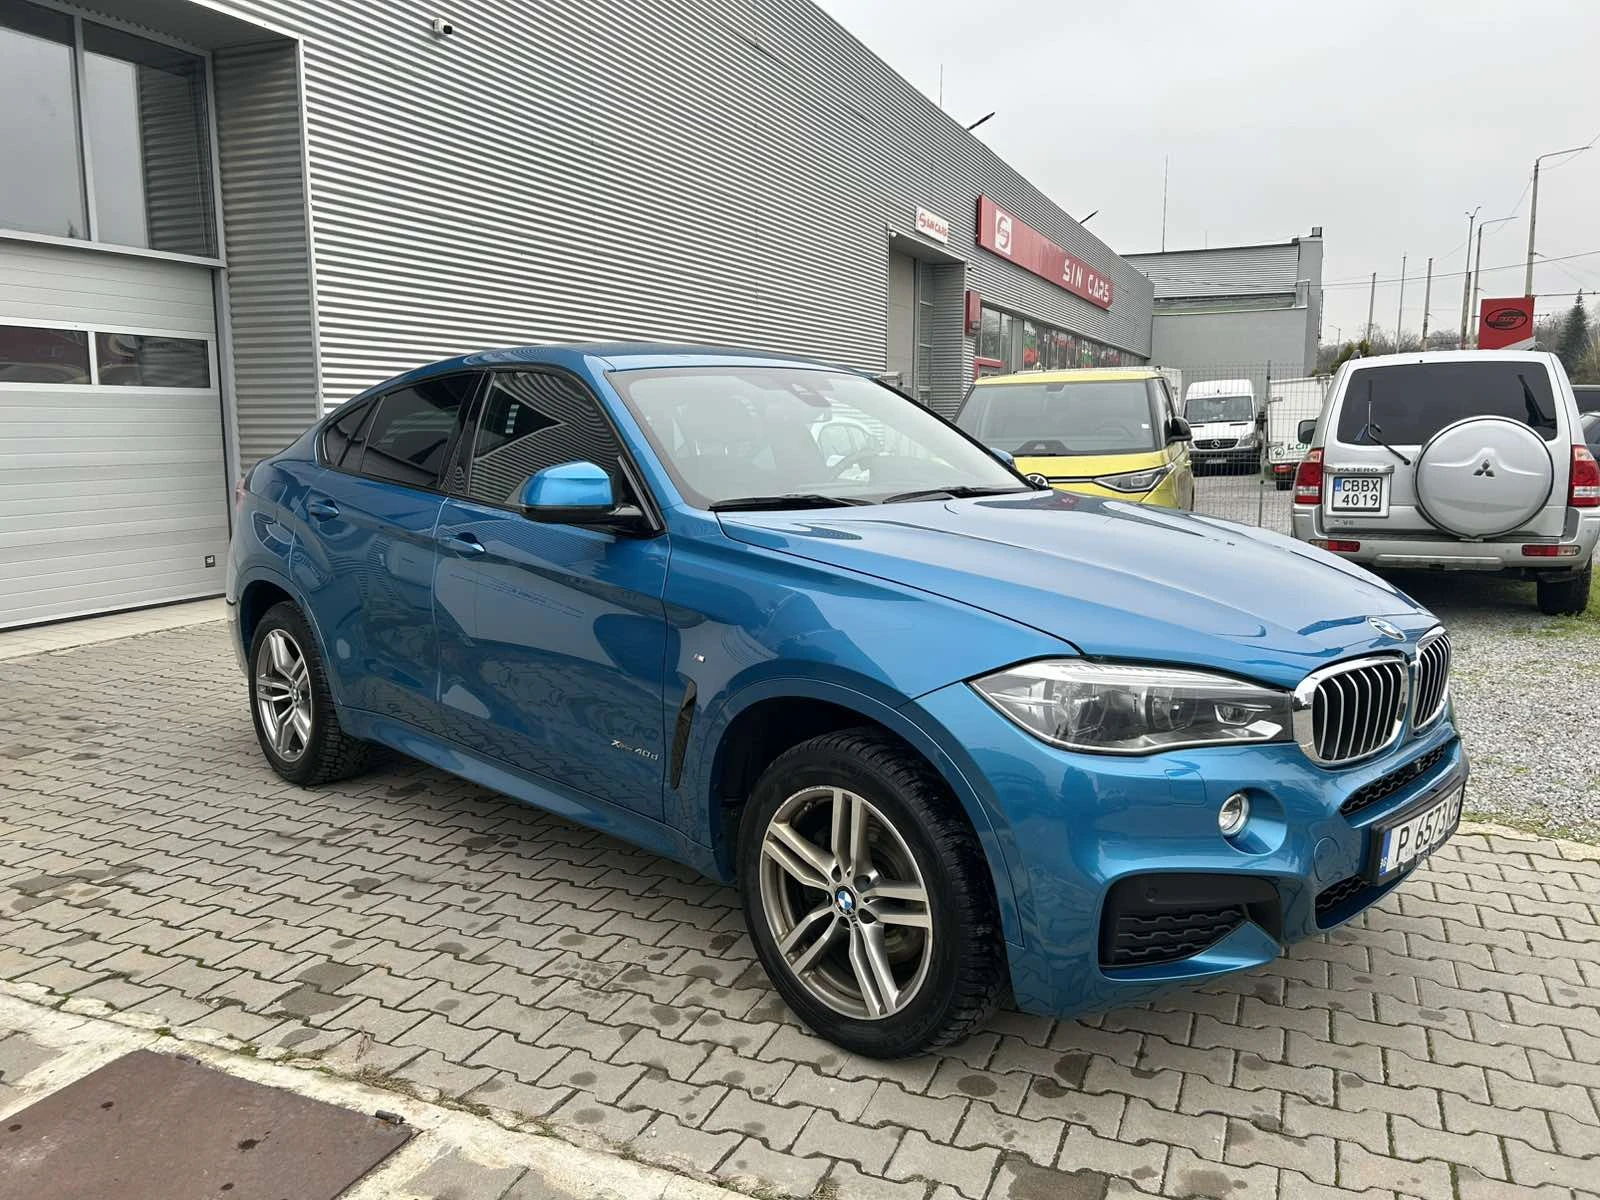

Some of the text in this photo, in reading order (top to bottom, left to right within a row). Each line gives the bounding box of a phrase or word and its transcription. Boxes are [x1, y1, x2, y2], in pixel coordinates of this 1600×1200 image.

[1062, 258, 1110, 303] SIN CARS
[1342, 479, 1379, 492] CBBX
[1342, 494, 1378, 506] 4019
[1396, 826, 1410, 862] P
